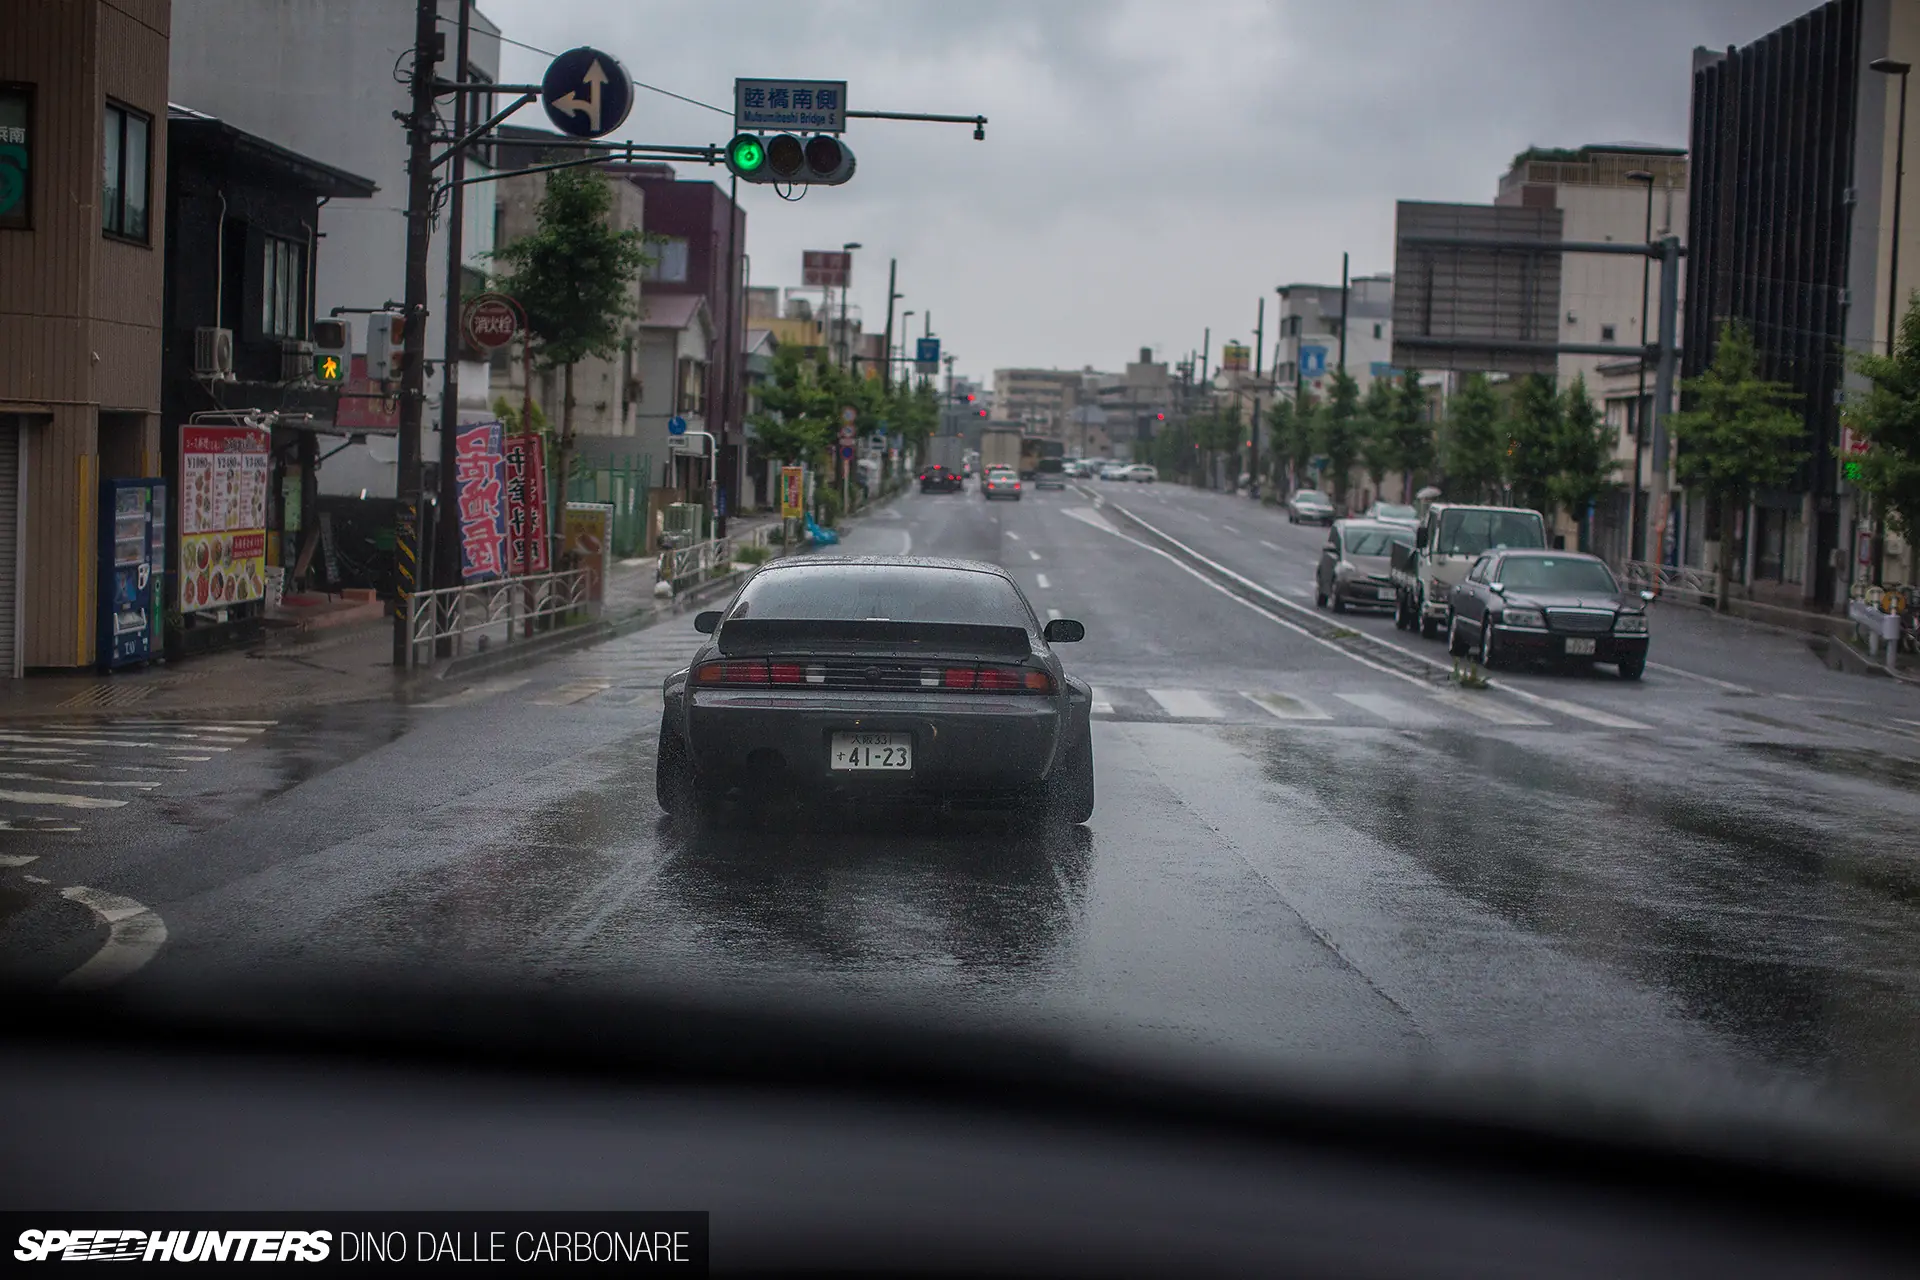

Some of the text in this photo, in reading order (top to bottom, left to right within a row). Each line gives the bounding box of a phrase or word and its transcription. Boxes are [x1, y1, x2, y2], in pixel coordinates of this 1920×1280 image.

[745, 88, 837, 109] 睦橋南側
[801, 112, 825, 126] Bridge
[474, 315, 512, 334] 消火栓
[456, 424, 502, 577] 居酒屋
[848, 747, 908, 767] 41-23
